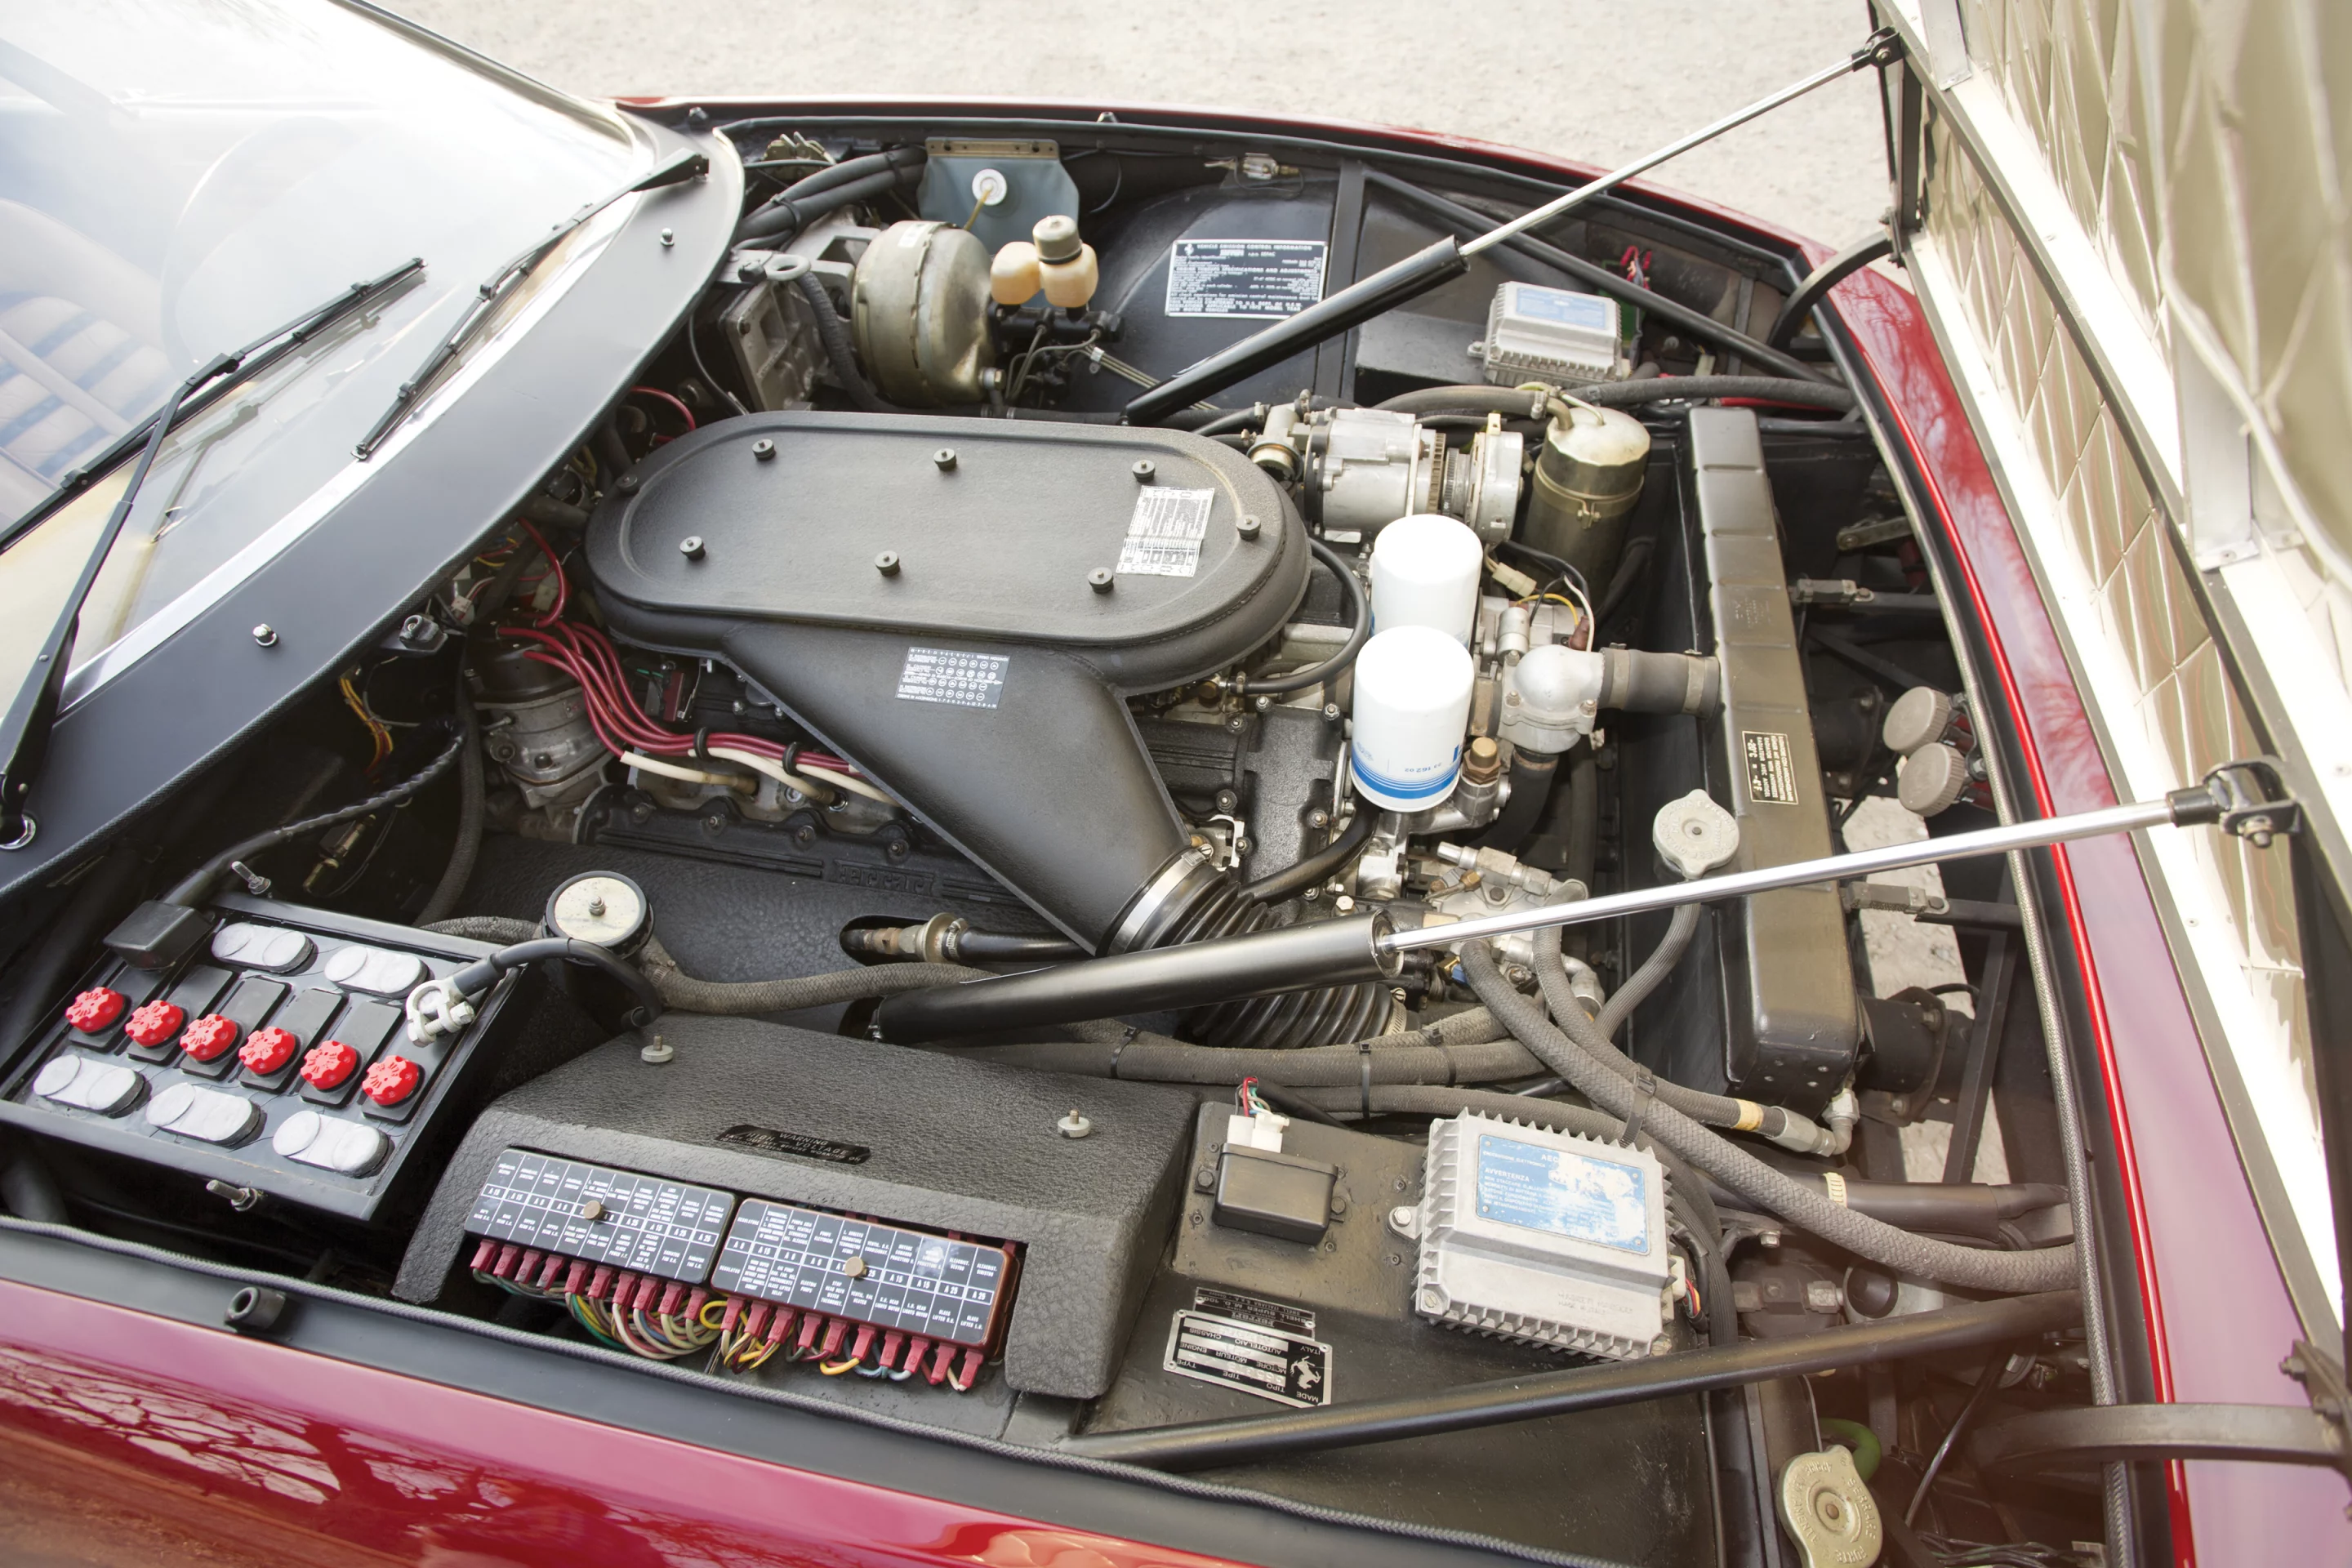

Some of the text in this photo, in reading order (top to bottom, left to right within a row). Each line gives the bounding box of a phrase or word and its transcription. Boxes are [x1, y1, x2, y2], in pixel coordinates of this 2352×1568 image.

[720, 1138, 753, 1146] IGNITION
[746, 1133, 850, 1156] HIGH VOLTAGE
[779, 1133, 829, 1146] WARNING
[1485, 1167, 1530, 1182] AVVERTENZA
[702, 1234, 711, 1242] 25
[867, 1269, 876, 1277] 25
[895, 1275, 903, 1283] 15
[922, 1281, 930, 1289] 15
[949, 1285, 958, 1294] 25
[977, 1291, 986, 1300] 25
[1254, 1300, 1279, 1310] ITALIANA
[1247, 1306, 1276, 1316] SUPER
[1282, 1307, 1300, 1316] SHELL
[1231, 1312, 1275, 1327] Ferrari
[1280, 1312, 1304, 1323] SHELL
[1189, 1328, 1222, 1339] CHASSIS
[1179, 1342, 1207, 1353] ENGINE
[1235, 1339, 1281, 1355] AUTOTELAIO
[1299, 1345, 1321, 1356] ITALY
[1215, 1351, 1247, 1363] MOTEUR
[1256, 1361, 1286, 1374] MOTORE
[1177, 1359, 1285, 1393] TIPO TIPE TYPE
[1296, 1391, 1319, 1402] MADE
[1847, 1478, 1876, 1539] SERRARE
